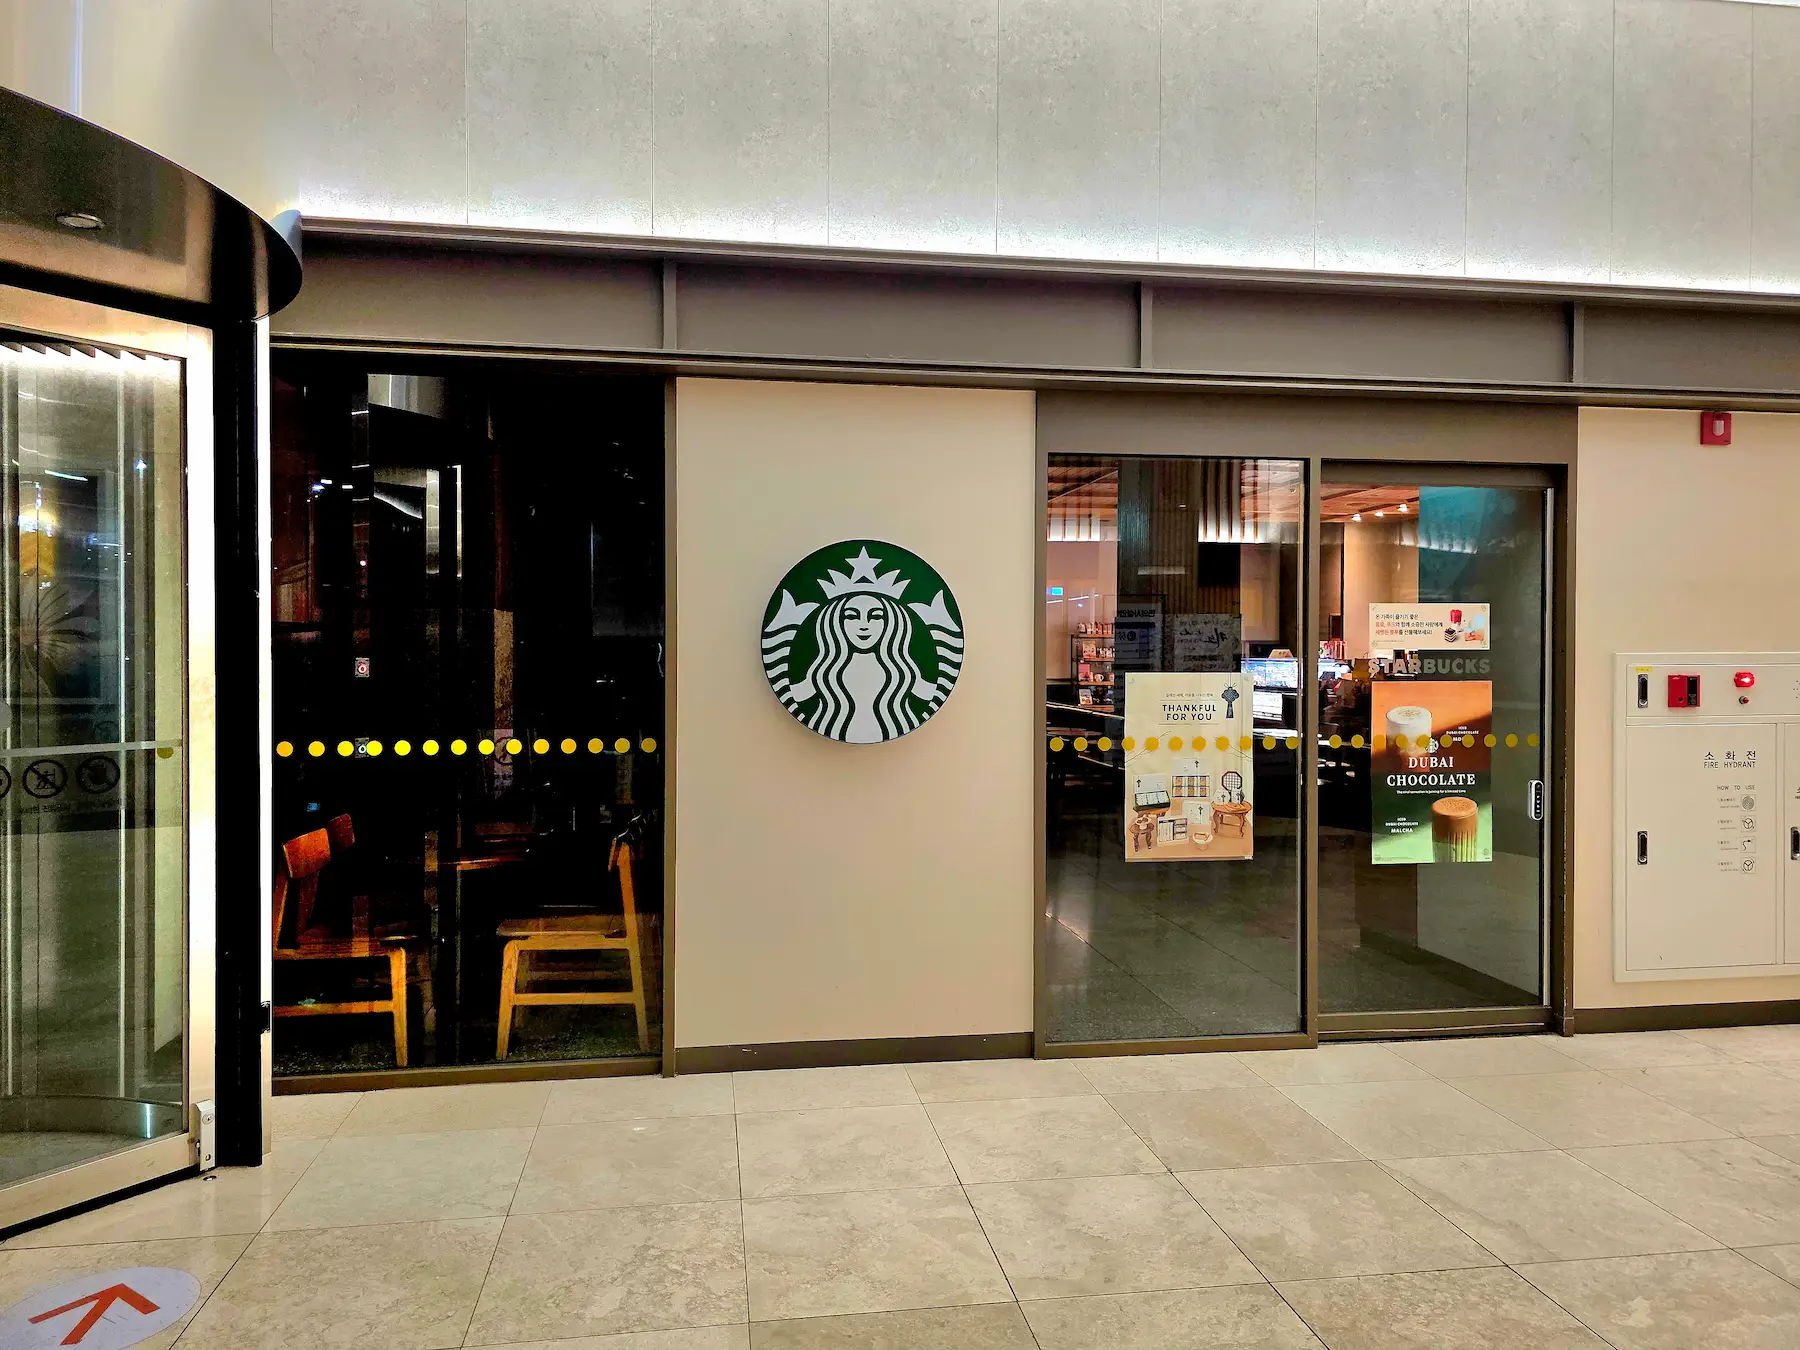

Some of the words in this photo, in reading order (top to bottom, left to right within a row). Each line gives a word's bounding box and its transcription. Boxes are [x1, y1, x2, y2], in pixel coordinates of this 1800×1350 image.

[1368, 658, 1491, 675] STARBUCKS
[1408, 756, 1454, 768] DUBAI
[1386, 774, 1476, 786] CHOCOLATE
